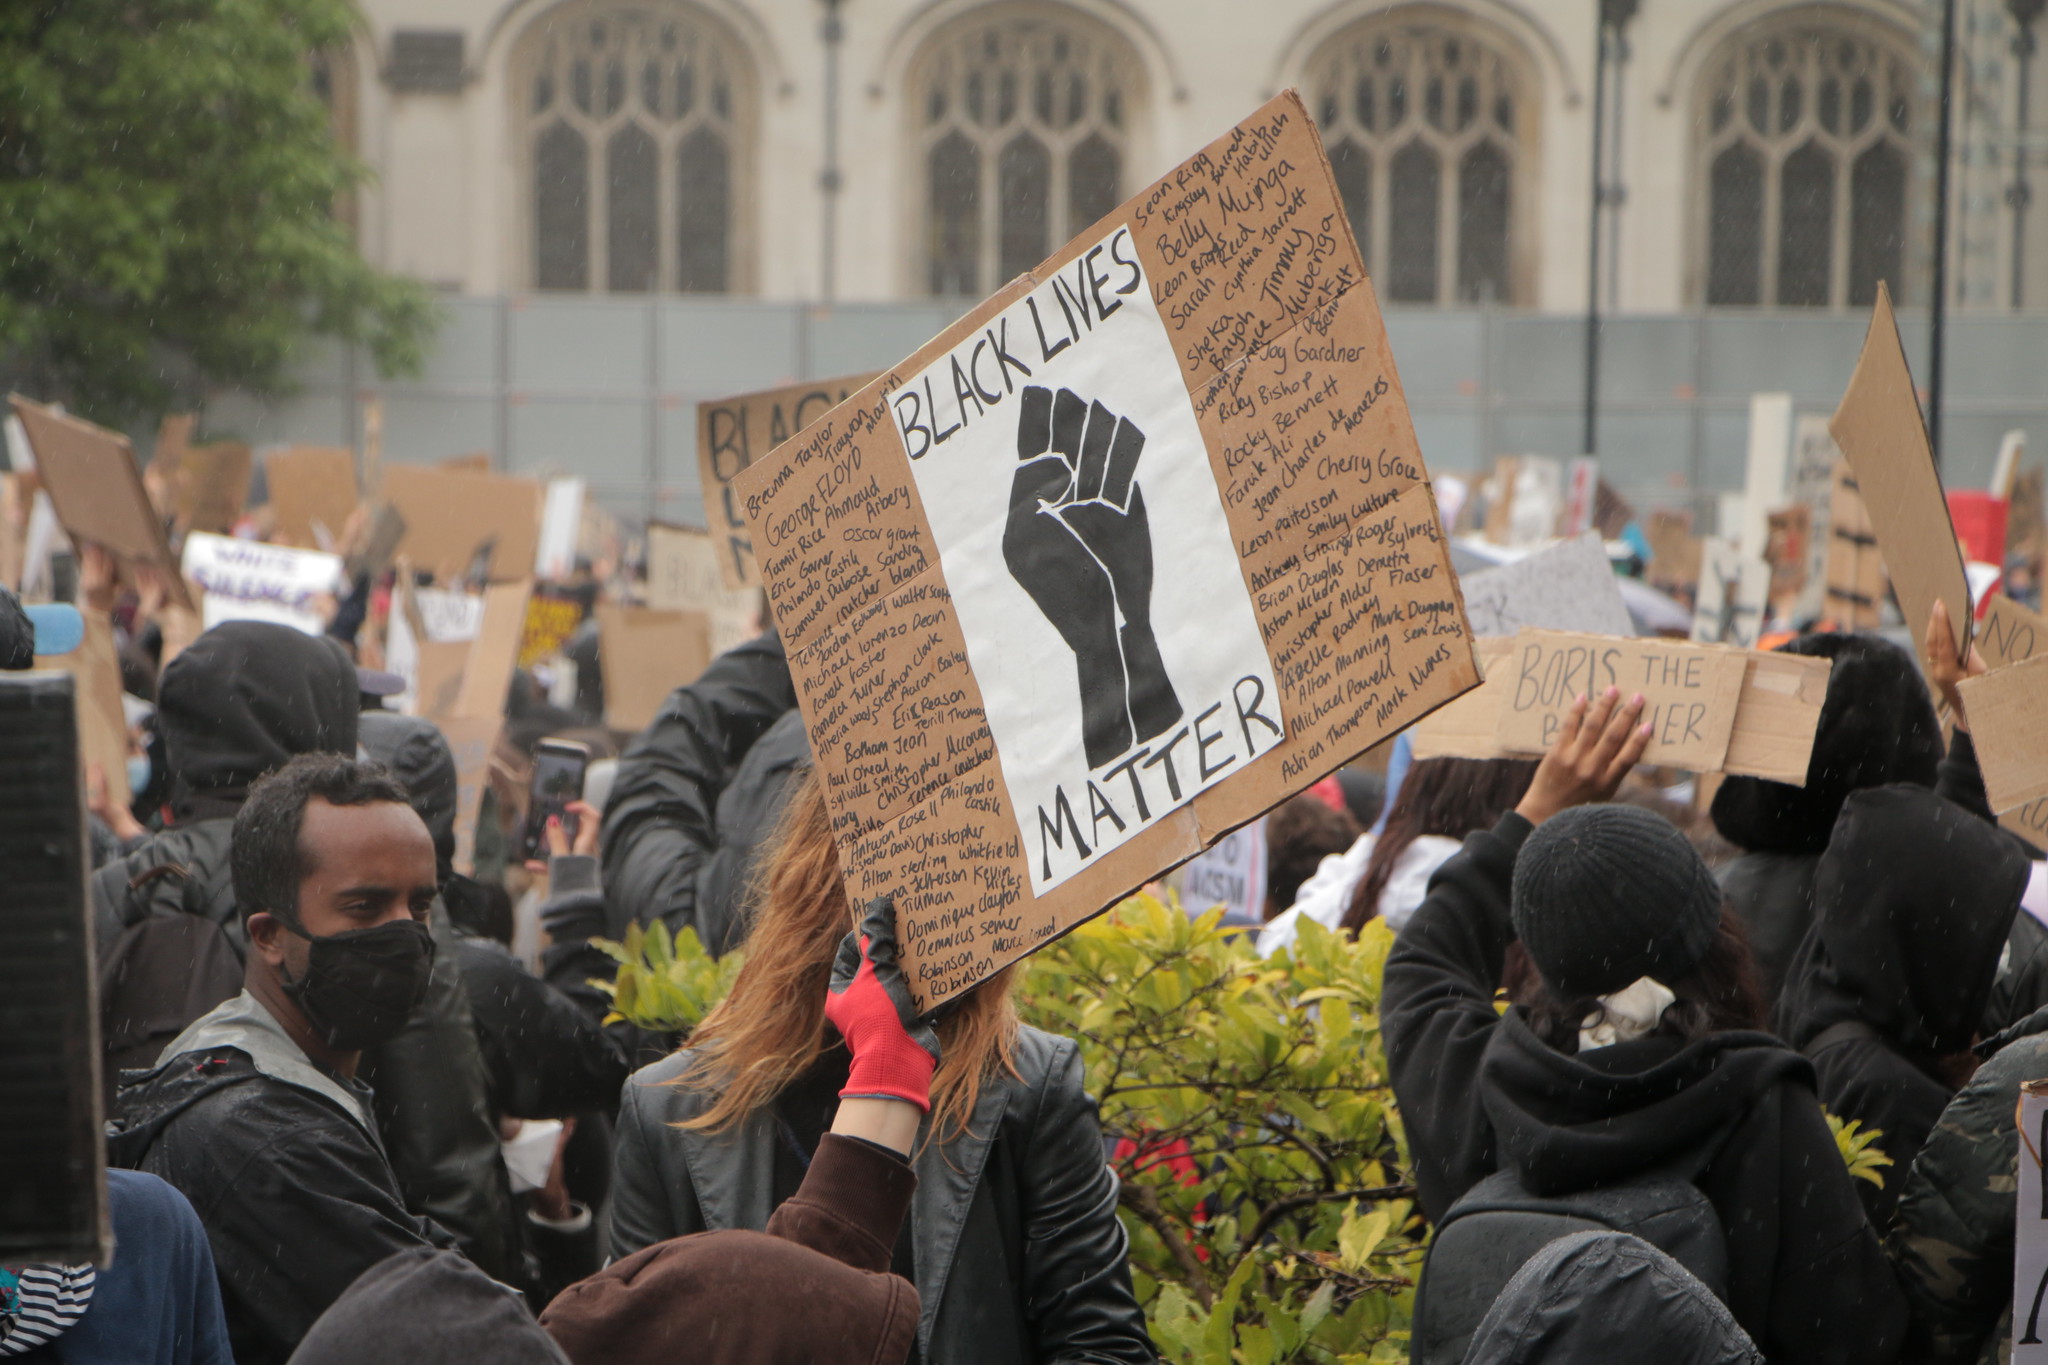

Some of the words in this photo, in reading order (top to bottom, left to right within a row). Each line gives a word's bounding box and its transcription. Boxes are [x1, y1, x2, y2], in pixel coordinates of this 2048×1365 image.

[1233, 125, 1268, 179] Habib
[1135, 181, 1173, 228] Sean
[1176, 152, 1215, 192] Rigg
[1156, 218, 1217, 266] Belly
[1217, 159, 1296, 226] Mujinga
[1156, 270, 1188, 306] Leon
[1170, 278, 1216, 331] Sarah
[894, 317, 1032, 461] BLACK
[1025, 229, 1141, 363] LIVES
[1259, 340, 1288, 376] Joy
[1294, 336, 1366, 363] Gardner
[1257, 371, 1313, 406] Bishop
[1223, 428, 1274, 477] Rocky
[1271, 374, 1339, 435] Bennett
[746, 464, 795, 521] Breonna
[794, 421, 833, 468] Taylor
[1281, 430, 1327, 489] Charles
[764, 493, 821, 548] George
[815, 445, 862, 505] FLOYD
[824, 474, 881, 529] Ahmaud
[865, 485, 911, 524] Arbery
[1356, 515, 1397, 547] Roger
[763, 547, 798, 580] Tamir
[797, 527, 826, 555] Rice
[771, 577, 796, 601] Eric
[799, 550, 834, 580] Garner
[1339, 576, 1373, 610] Alder
[784, 595, 828, 646] Samuel
[826, 565, 872, 601] Dubose
[1257, 585, 1294, 613] Brian
[803, 648, 855, 695] Michael
[912, 609, 946, 632] Dean
[850, 668, 886, 705] Turner
[900, 671, 936, 702] Aaron
[1290, 684, 1345, 741] Michael
[1346, 654, 1396, 703] Powell
[1299, 672, 1332, 705] Alton
[1514, 644, 1622, 712] BORIS
[1641, 655, 1705, 688] THE
[920, 689, 966, 714] Reason
[893, 731, 928, 755] Jean
[1281, 741, 1325, 784] Adrian
[827, 768, 850, 787] Paul
[898, 809, 928, 835] Rose
[862, 869, 893, 891] Alton
[906, 903, 975, 944] Dominique
[918, 950, 974, 983] Robinson
[930, 957, 994, 995] Robinson
